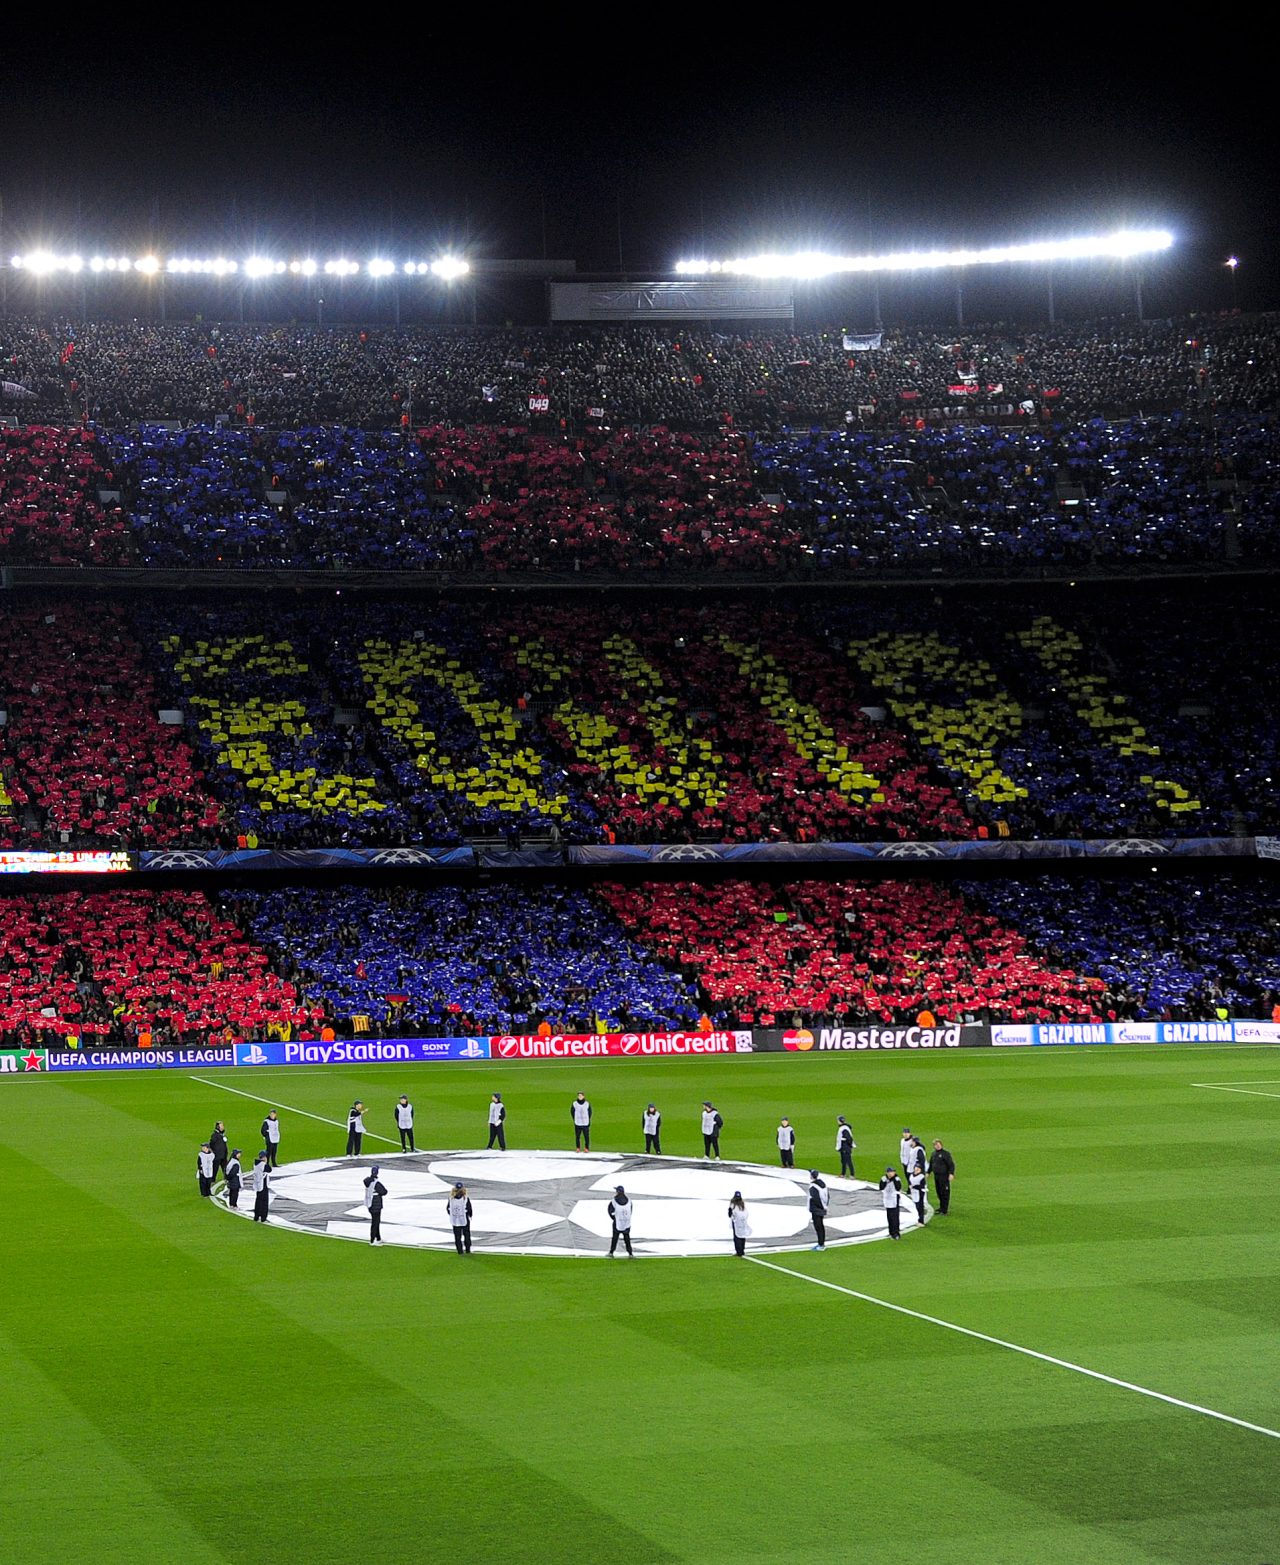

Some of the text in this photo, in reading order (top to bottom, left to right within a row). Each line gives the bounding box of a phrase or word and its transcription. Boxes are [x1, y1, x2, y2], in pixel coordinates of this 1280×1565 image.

[528, 398, 548, 411] 049
[642, 1032, 729, 1053] UniCredit
[819, 1027, 961, 1048] MasterCard
[1039, 1024, 1106, 1044] GAZPROM
[1163, 1023, 1232, 1042] GAZPROM
[285, 1041, 410, 1064] PlayStation
[422, 1043, 451, 1051] SONY
[520, 1036, 609, 1056] UniCredit
[49, 1049, 232, 1065] UEFA CHAMPIONS LEAGUE
